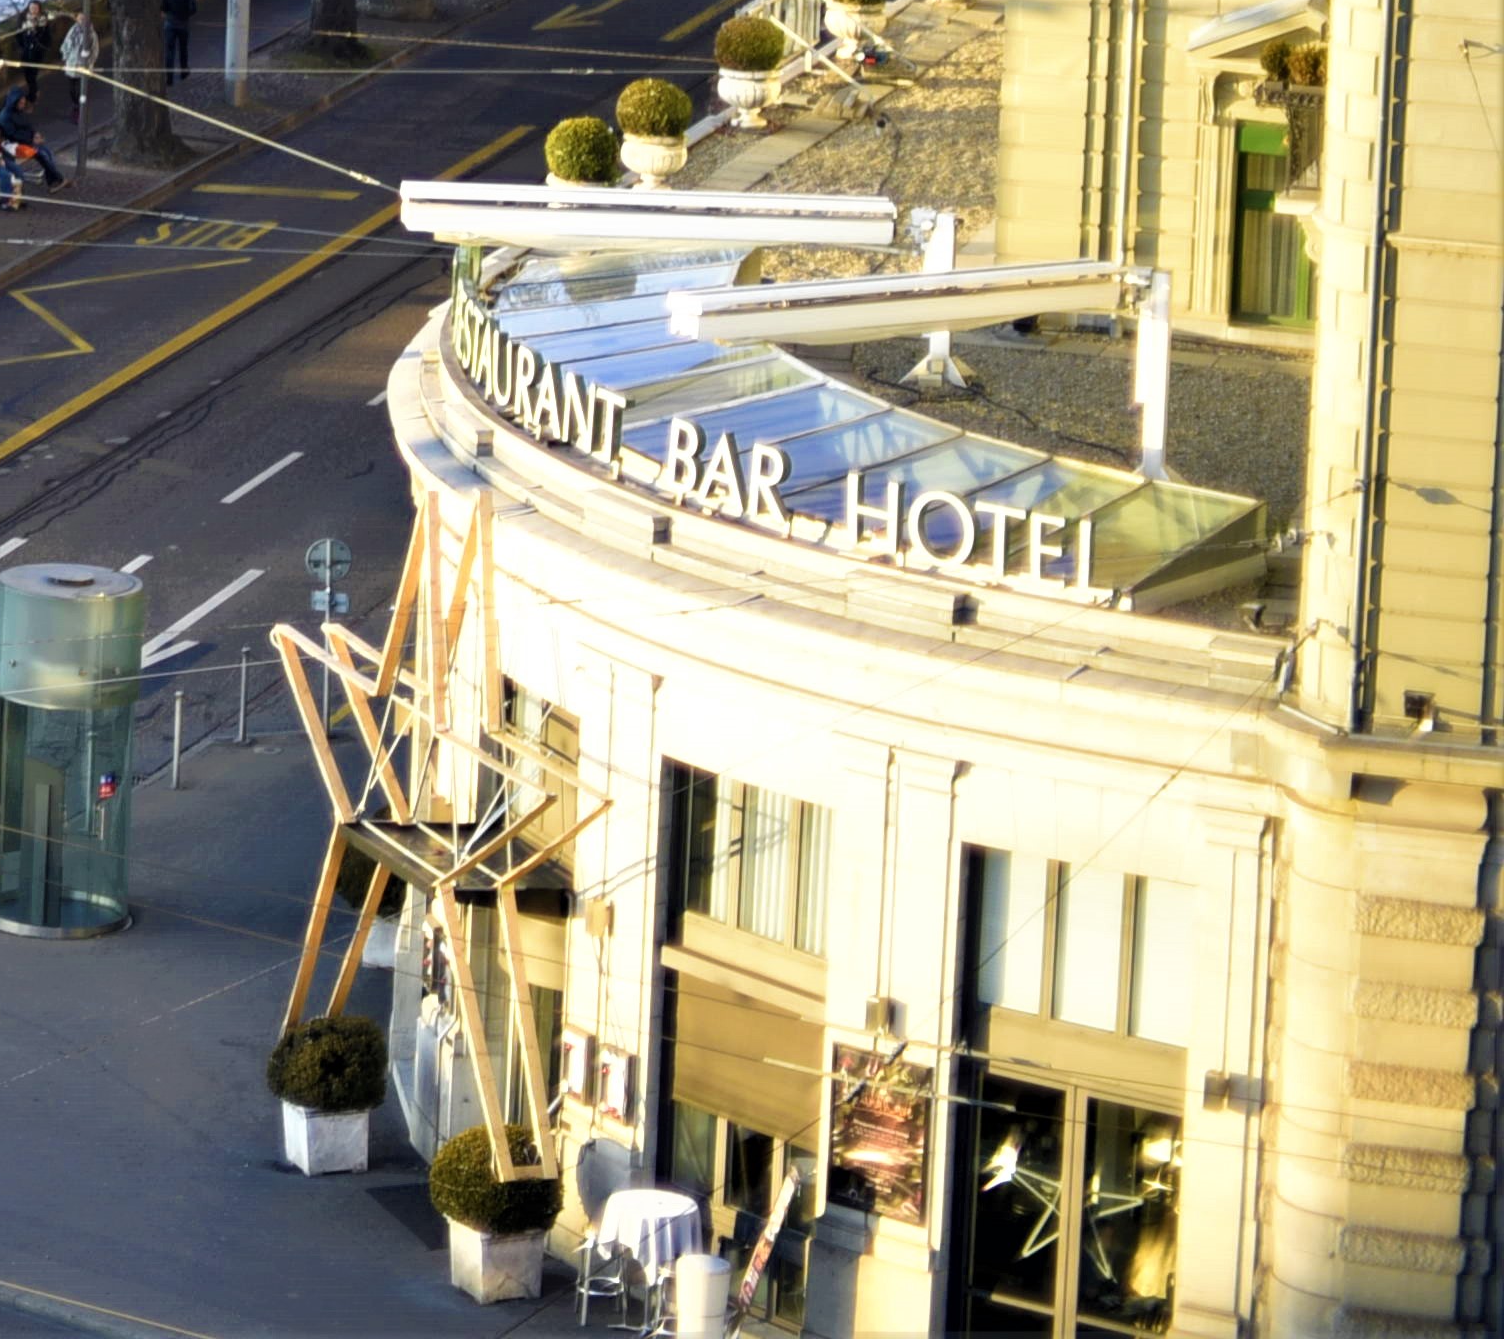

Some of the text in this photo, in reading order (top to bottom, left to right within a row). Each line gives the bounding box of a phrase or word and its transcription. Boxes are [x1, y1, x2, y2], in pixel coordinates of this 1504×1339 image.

[135, 220, 279, 251] BUS
[453, 258, 1113, 598] ESTAURANT BAR HOTEL
